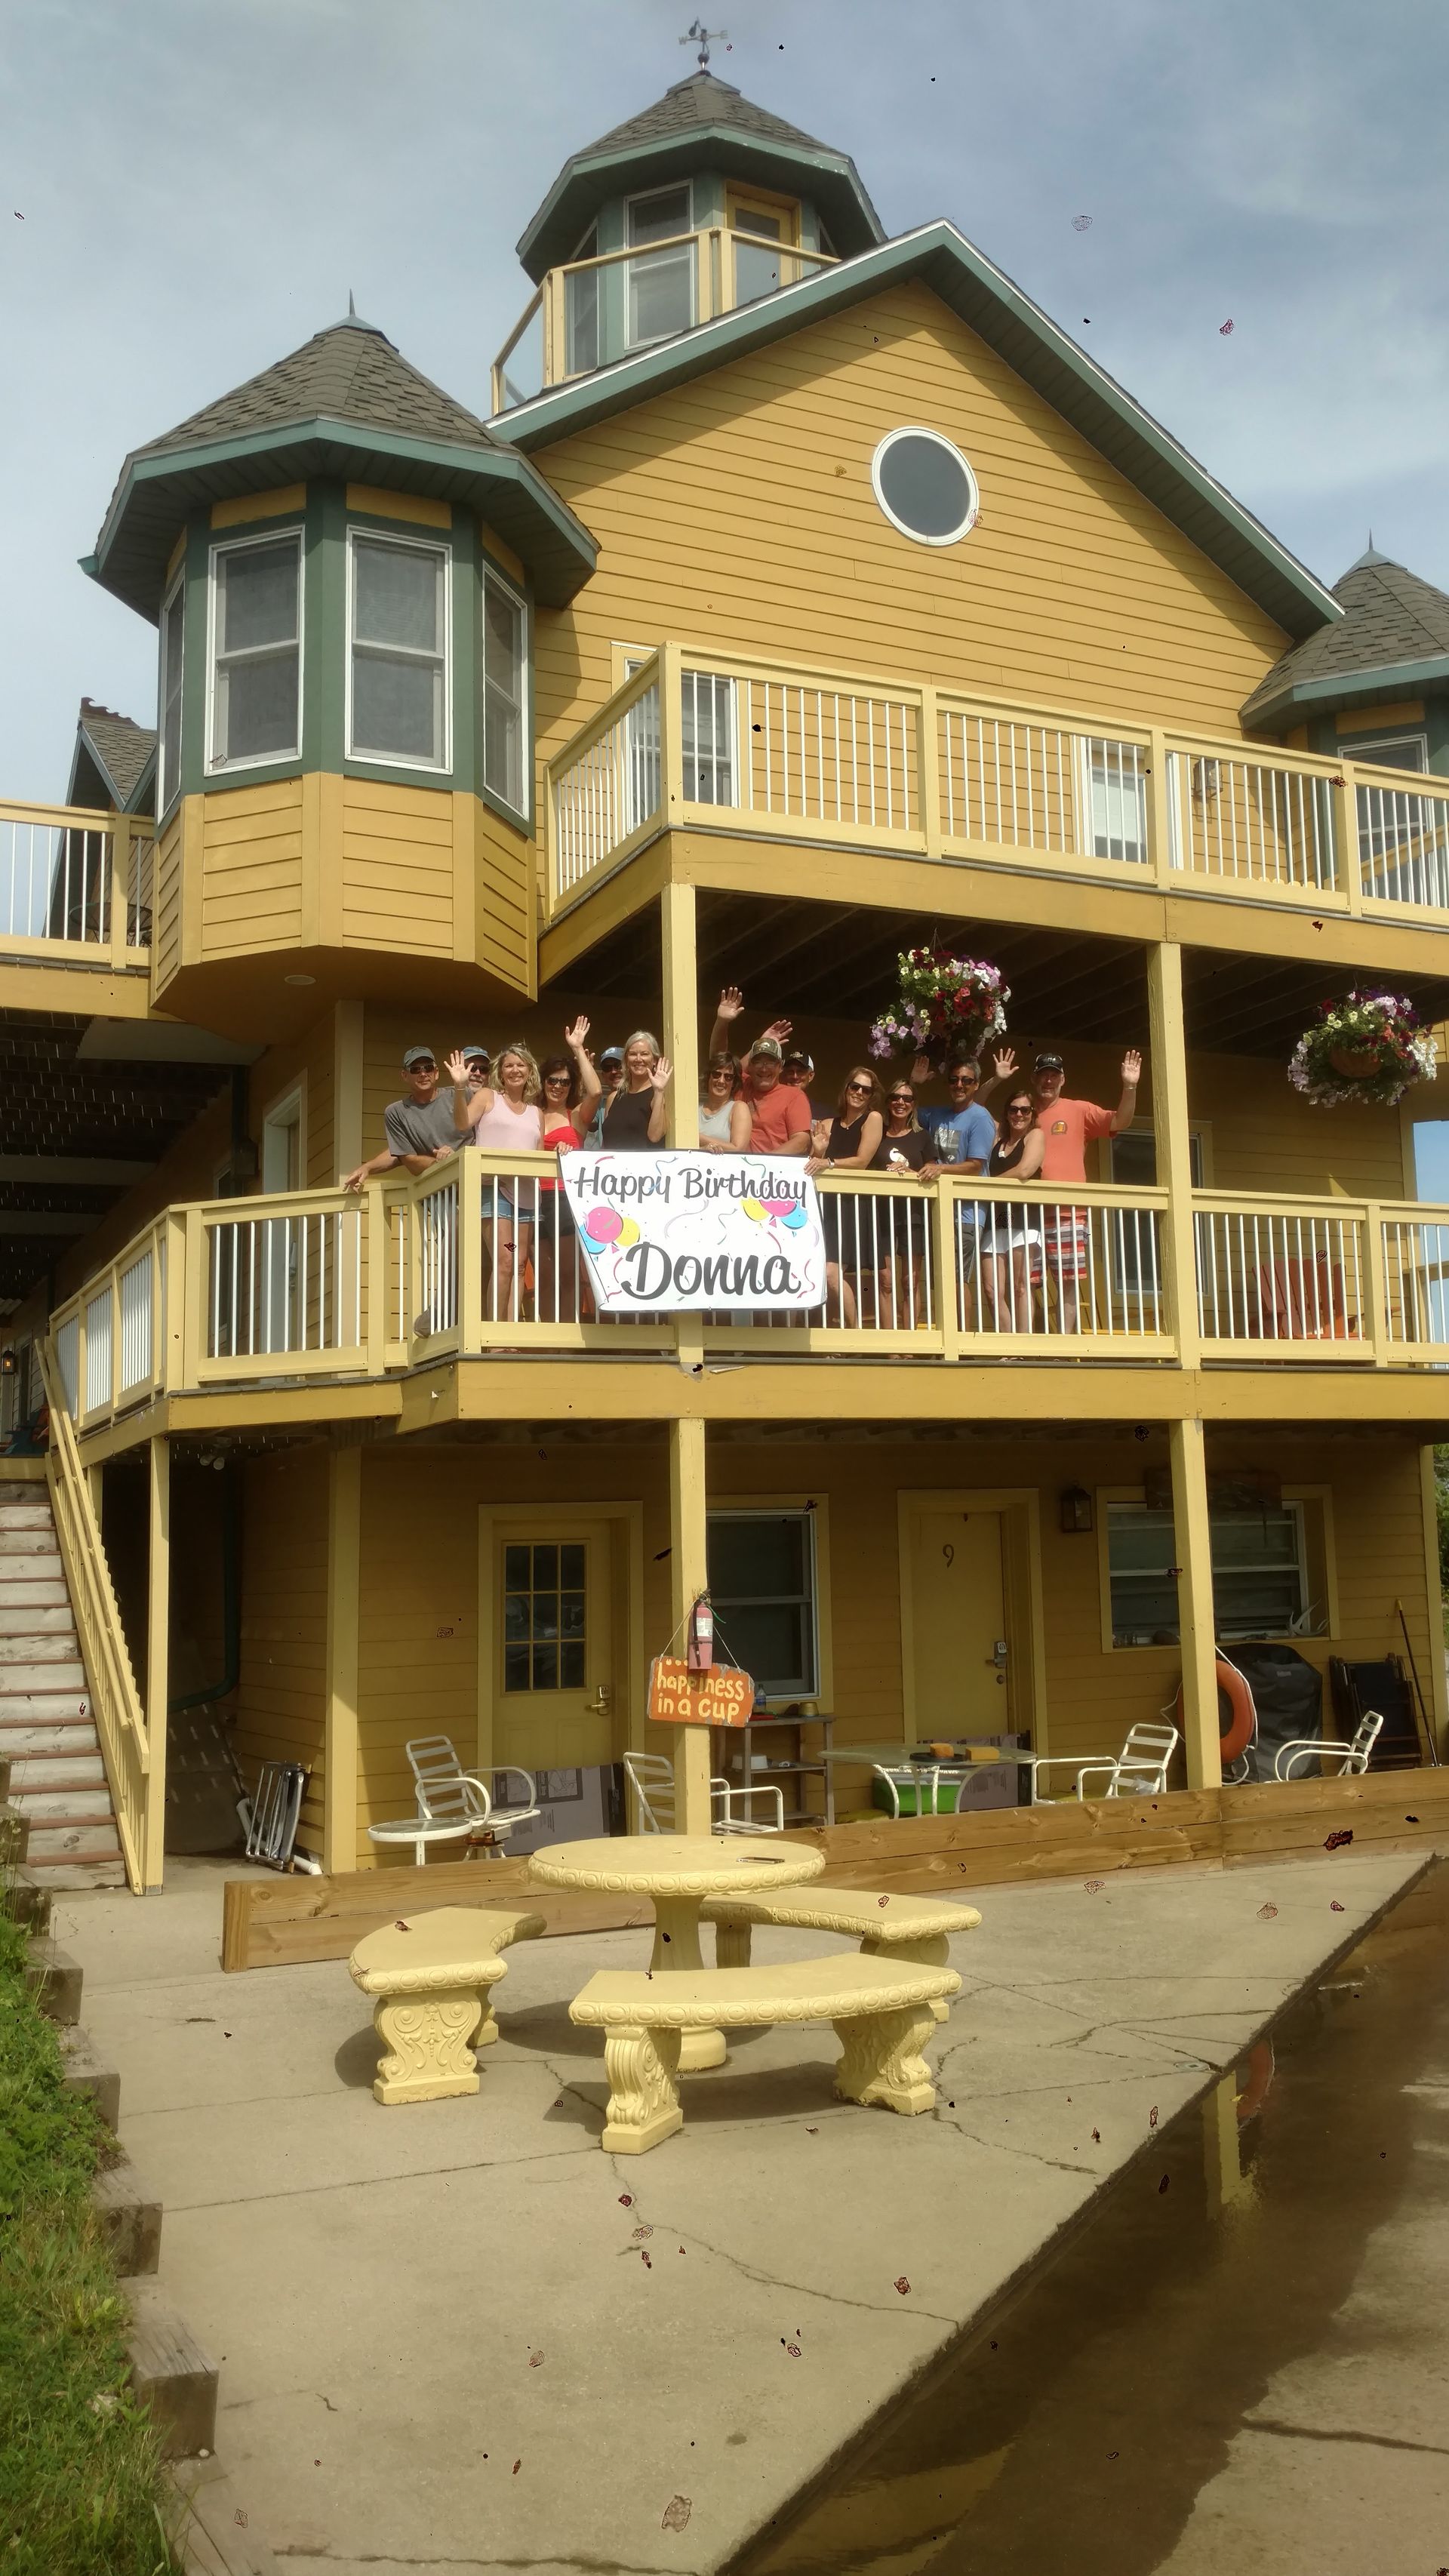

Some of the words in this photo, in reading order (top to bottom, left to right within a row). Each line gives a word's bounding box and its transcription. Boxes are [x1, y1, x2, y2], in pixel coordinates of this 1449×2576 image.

[574, 1166, 671, 1204] Happy
[678, 1168, 807, 1208] Birthday
[620, 1242, 801, 1300] Donna
[943, 1544, 955, 1568] 9
[657, 1662, 745, 1701] happiness
[657, 1692, 674, 1715] in
[678, 1698, 691, 1716] a
[698, 1698, 740, 1725] cup
